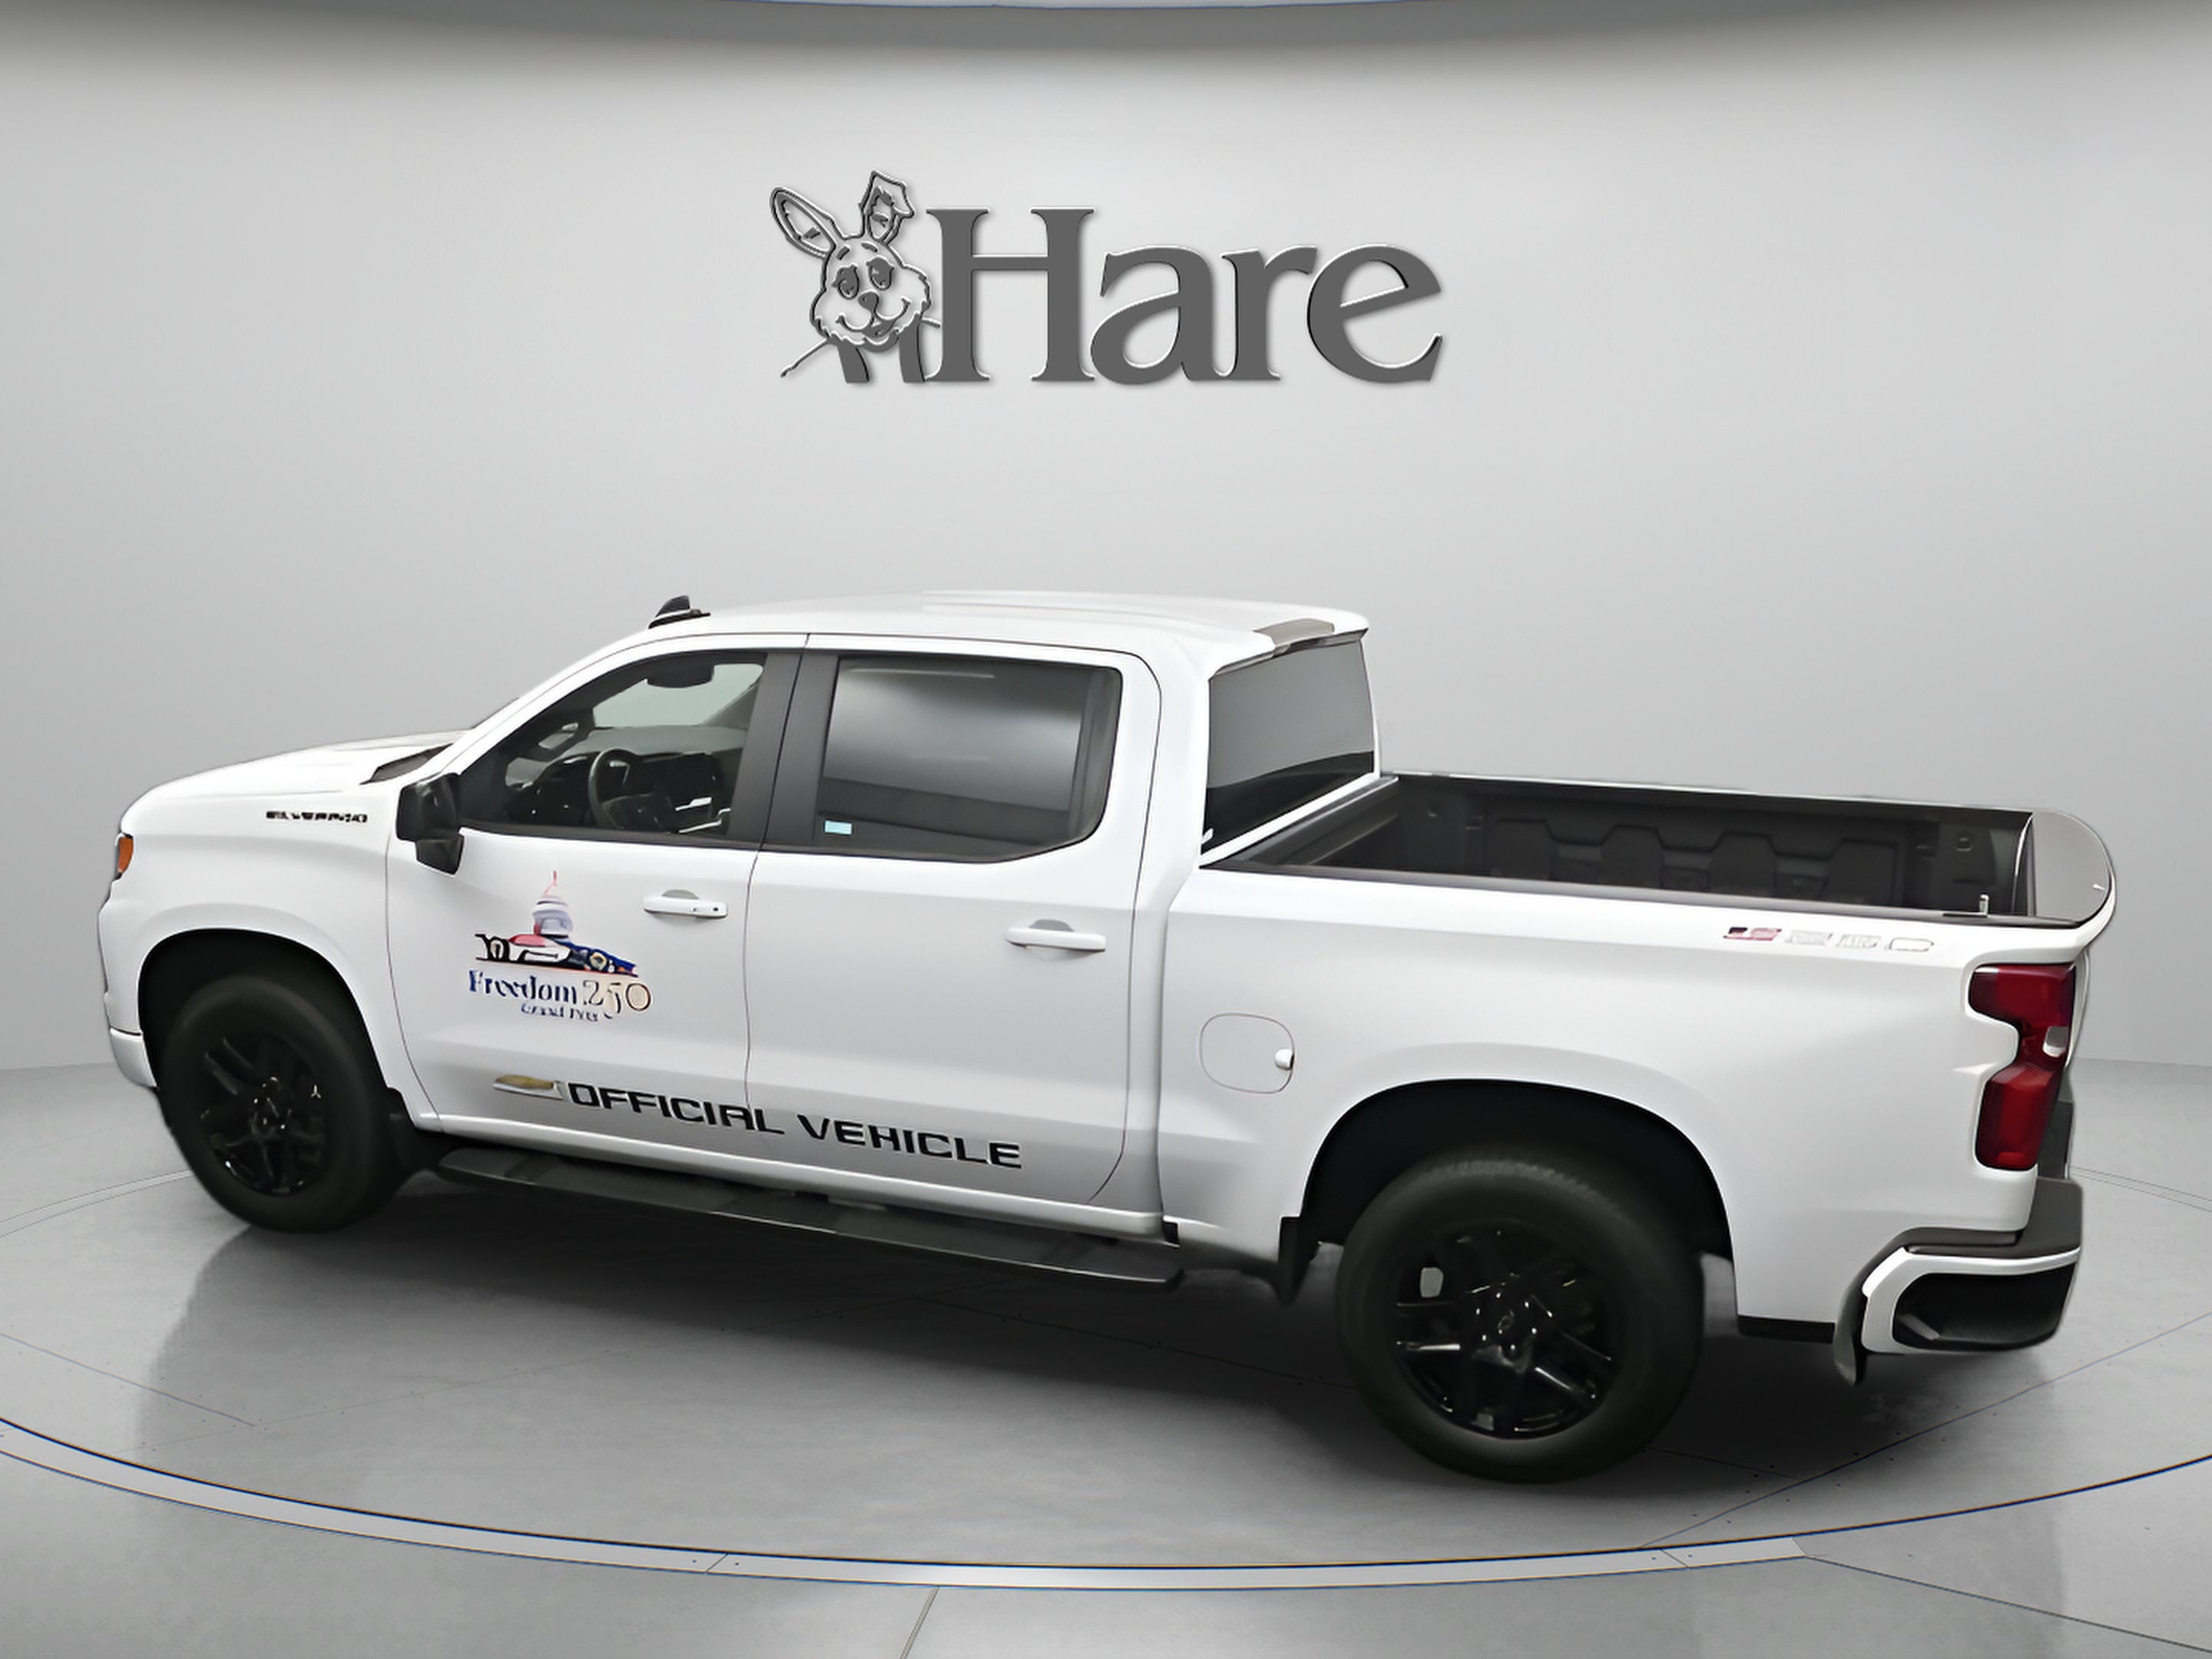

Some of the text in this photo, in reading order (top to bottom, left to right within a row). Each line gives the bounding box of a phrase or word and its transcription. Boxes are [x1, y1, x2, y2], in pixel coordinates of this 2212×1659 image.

[469, 970, 651, 1019] Freedom 250
[568, 1082, 1022, 1169] OFFICIAL VEHICLE
